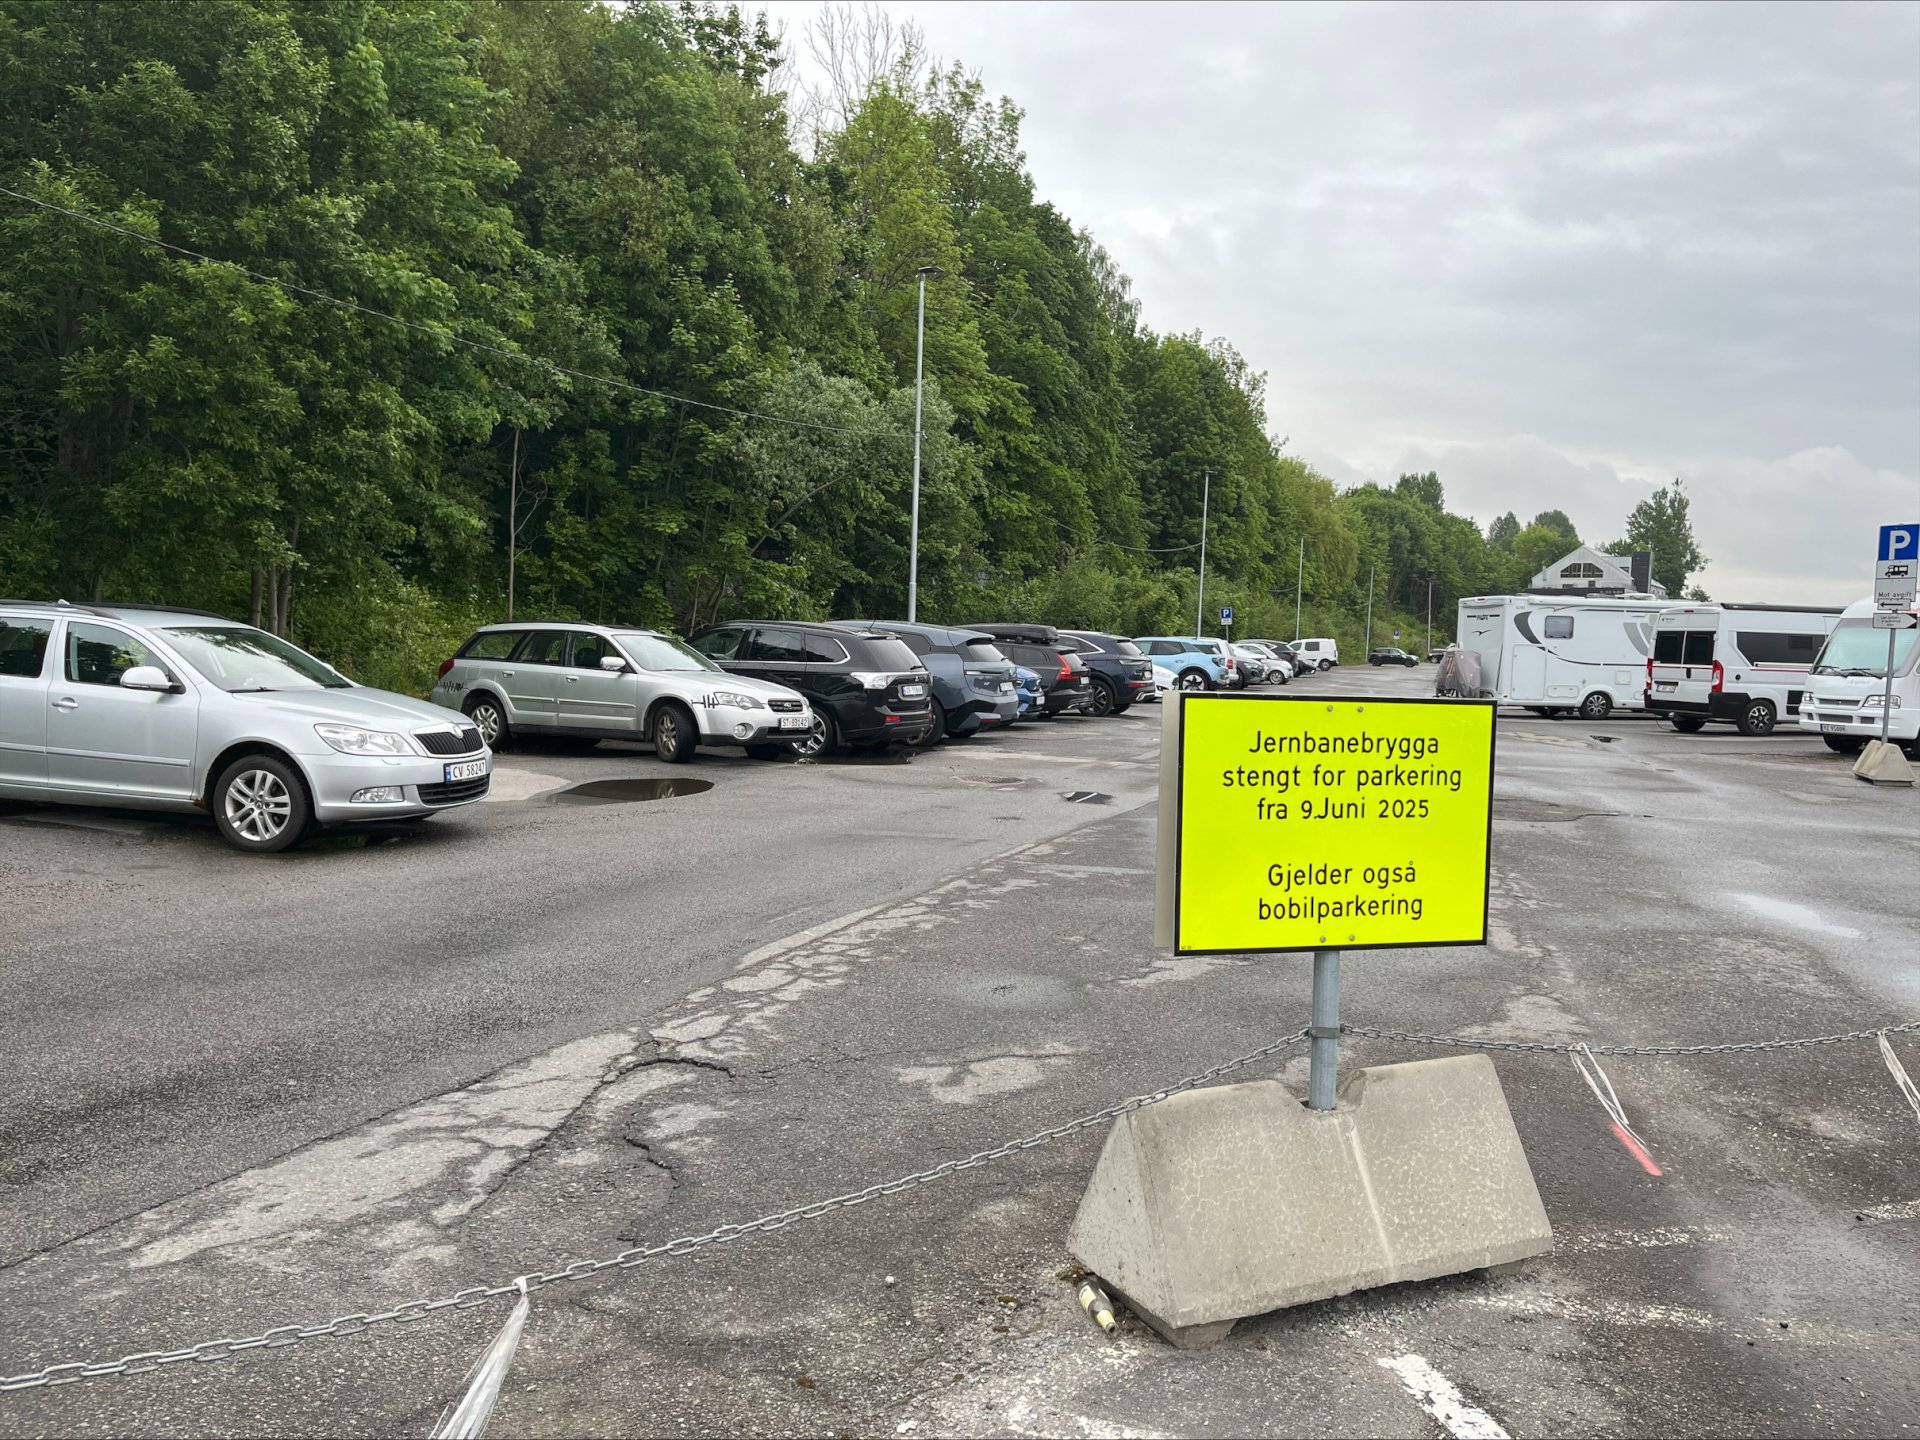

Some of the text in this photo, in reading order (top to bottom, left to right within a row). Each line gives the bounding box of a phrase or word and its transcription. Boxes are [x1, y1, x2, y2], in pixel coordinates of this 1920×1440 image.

[1888, 529, 1911, 560] P
[1223, 609, 1230, 618] P
[782, 718, 790, 727] ST
[1249, 731, 1439, 760] Jernbanebrygga
[452, 762, 485, 779] CV 58247
[1222, 764, 1462, 793] stengt for parkering
[1258, 798, 1288, 820] fra
[1378, 799, 1429, 819] 2025
[1268, 859, 1416, 892] Gjelder også
[1258, 894, 1423, 924] bobilparkering
